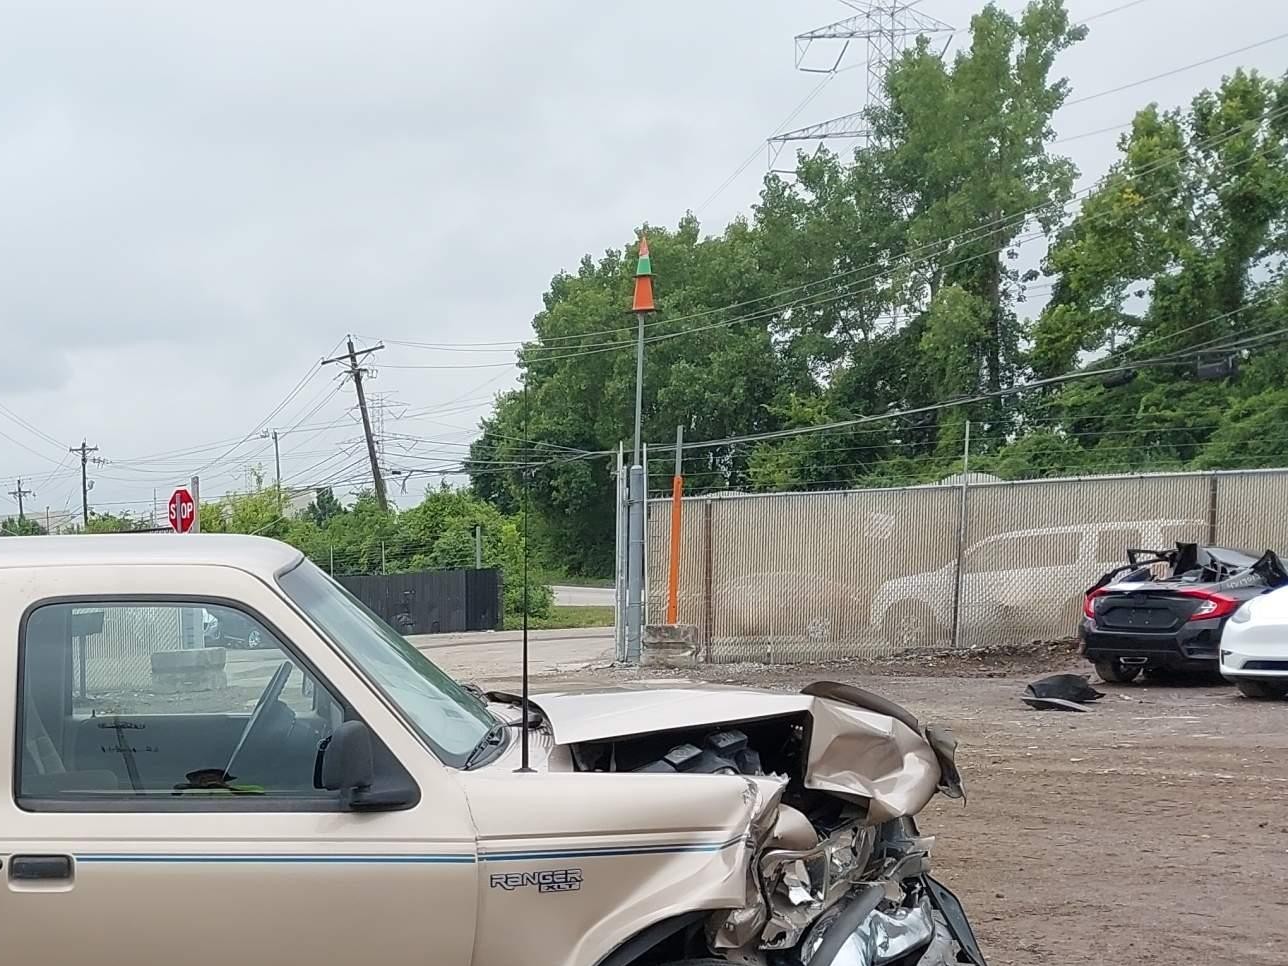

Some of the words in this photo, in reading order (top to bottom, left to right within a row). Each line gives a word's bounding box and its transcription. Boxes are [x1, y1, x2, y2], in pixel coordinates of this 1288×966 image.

[170, 502, 193, 518] SOP
[490, 868, 584, 890] RANGER
[543, 883, 575, 891] XLT
